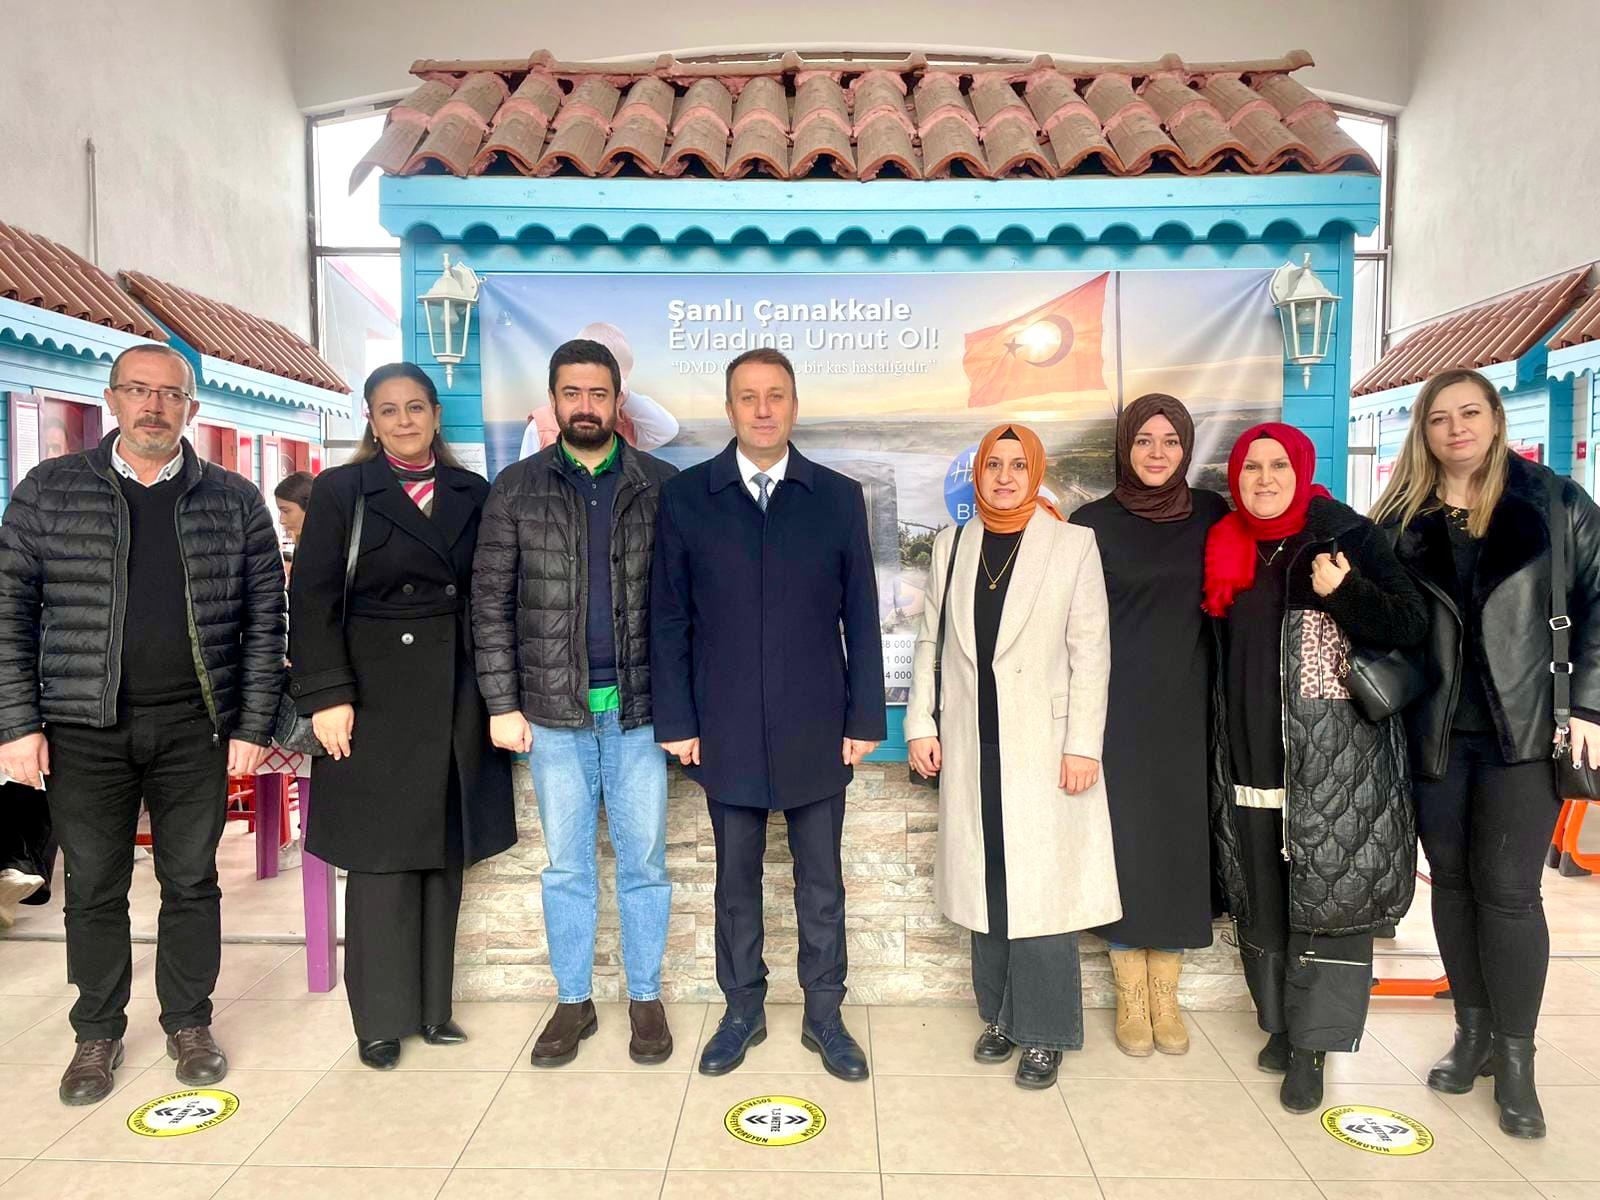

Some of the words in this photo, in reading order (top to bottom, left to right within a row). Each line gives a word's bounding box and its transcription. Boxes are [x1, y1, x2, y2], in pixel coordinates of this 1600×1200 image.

[668, 299, 743, 327] Şanlı
[753, 298, 911, 327] Çanakkale
[669, 327, 793, 350] Evladına
[806, 328, 888, 350] Umut
[897, 328, 939, 350] Ol!
[804, 360, 822, 374] bir
[826, 360, 848, 374] kas
[894, 640, 912, 649] 000
[894, 655, 912, 664] 000
[894, 671, 912, 679] 000
